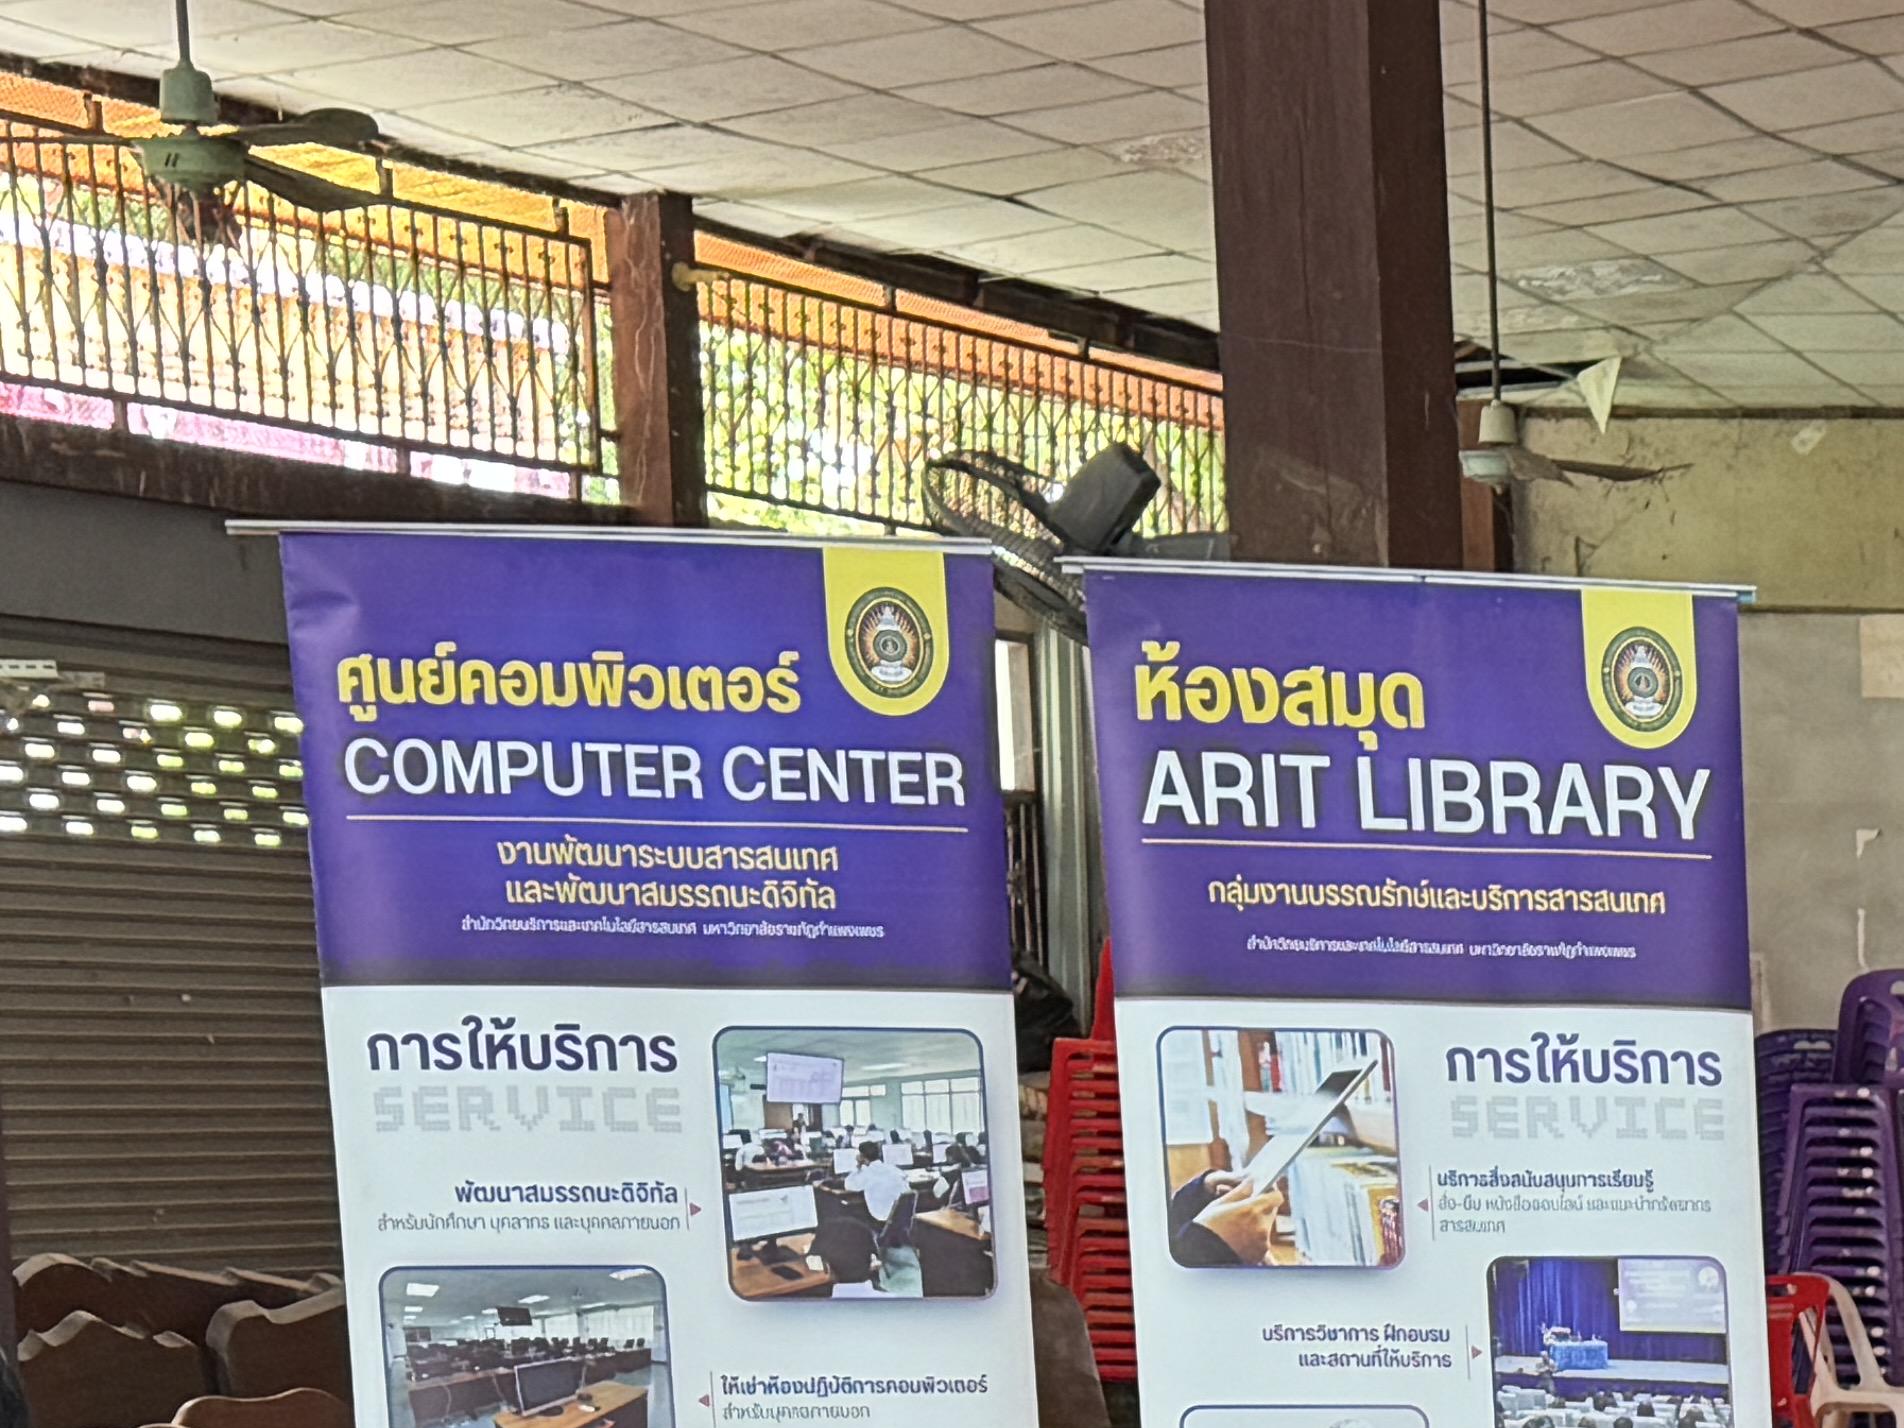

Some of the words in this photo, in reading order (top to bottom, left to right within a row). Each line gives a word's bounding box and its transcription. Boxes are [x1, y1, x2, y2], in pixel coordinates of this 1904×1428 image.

[337, 642, 801, 722] ศูนย์คอมพิวเตอร์
[1135, 640, 1426, 750] ห้องสมุด
[344, 737, 702, 798] COMPUTER
[723, 745, 965, 805] CENTER
[1141, 750, 1331, 828] ARIT
[1357, 755, 1712, 840] LIBRARY
[497, 837, 839, 872] งานพัฒนาระบบสารสนเทศ
[506, 877, 837, 910] และพัฒนาสมรรถนะดิจิทัล
[1208, 874, 1666, 914] กลุ่มงานบรรณรักษ์และบริการสารสนเทศ
[367, 1015, 678, 1074] การให้บริการ
[1444, 1032, 1723, 1088] การให้บริการ
[373, 1084, 683, 1133] SERVICE
[1449, 1094, 1726, 1141] SERVICE
[455, 1180, 678, 1204] พัฒนาสมรรถนะดิจิทัล
[1299, 1344, 1452, 1368] และสถานที่ให้บริการ
